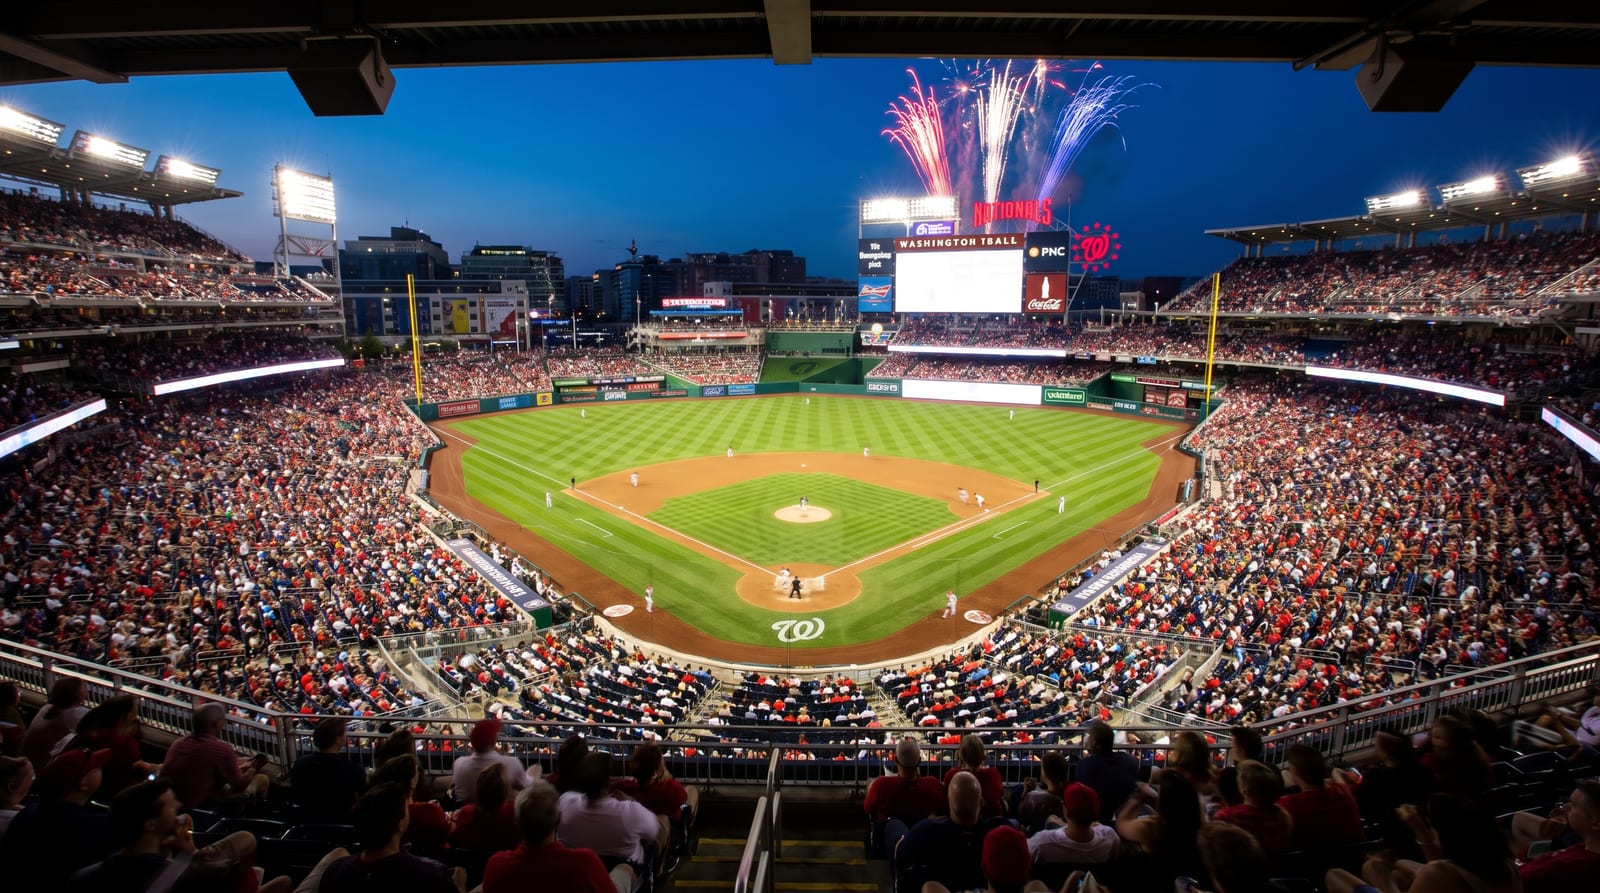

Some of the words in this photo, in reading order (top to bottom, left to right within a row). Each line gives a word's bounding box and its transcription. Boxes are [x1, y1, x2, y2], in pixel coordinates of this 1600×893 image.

[973, 198, 1052, 228] NATIONALS
[1041, 246, 1066, 257] PNC
[771, 617, 825, 643] W
